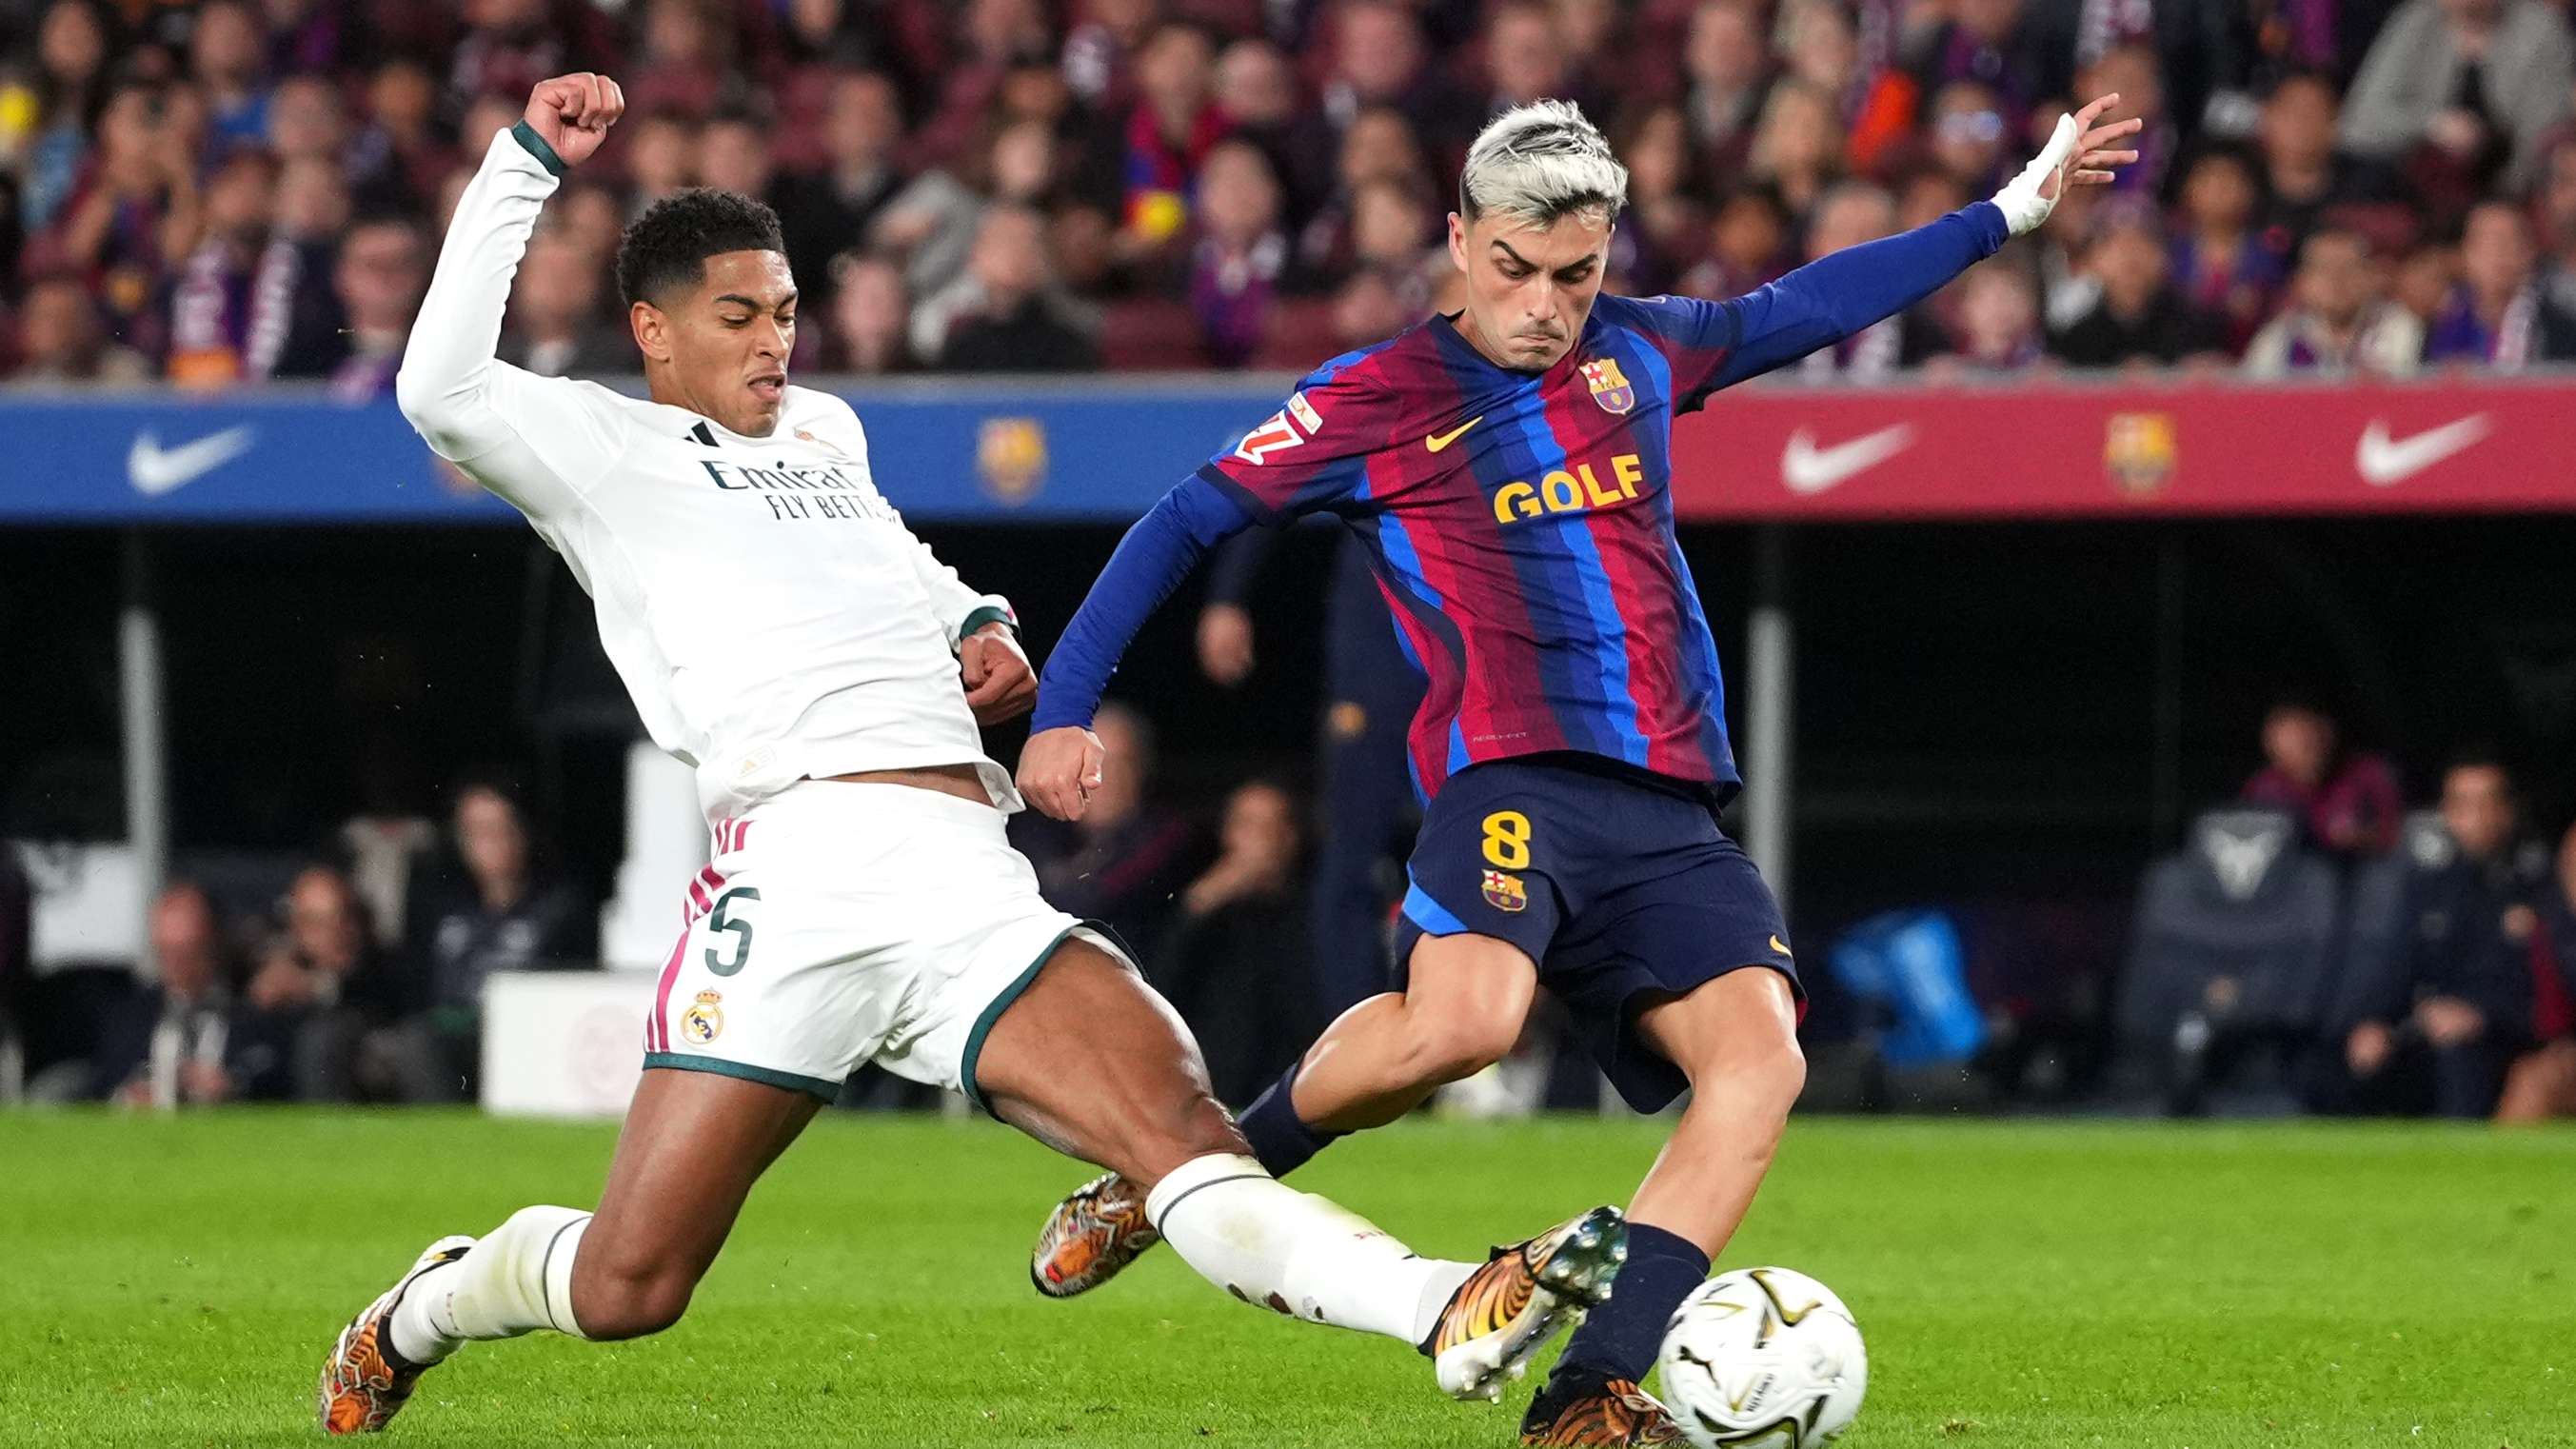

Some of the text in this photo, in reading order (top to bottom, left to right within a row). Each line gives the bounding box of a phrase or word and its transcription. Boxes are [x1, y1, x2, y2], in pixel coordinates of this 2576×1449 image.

[699, 460, 864, 490] Emirat
[1494, 453, 1643, 524] GOLF
[764, 494, 897, 524] FLY BETT
[1482, 810, 1532, 869] 8
[704, 886, 762, 977] 5
